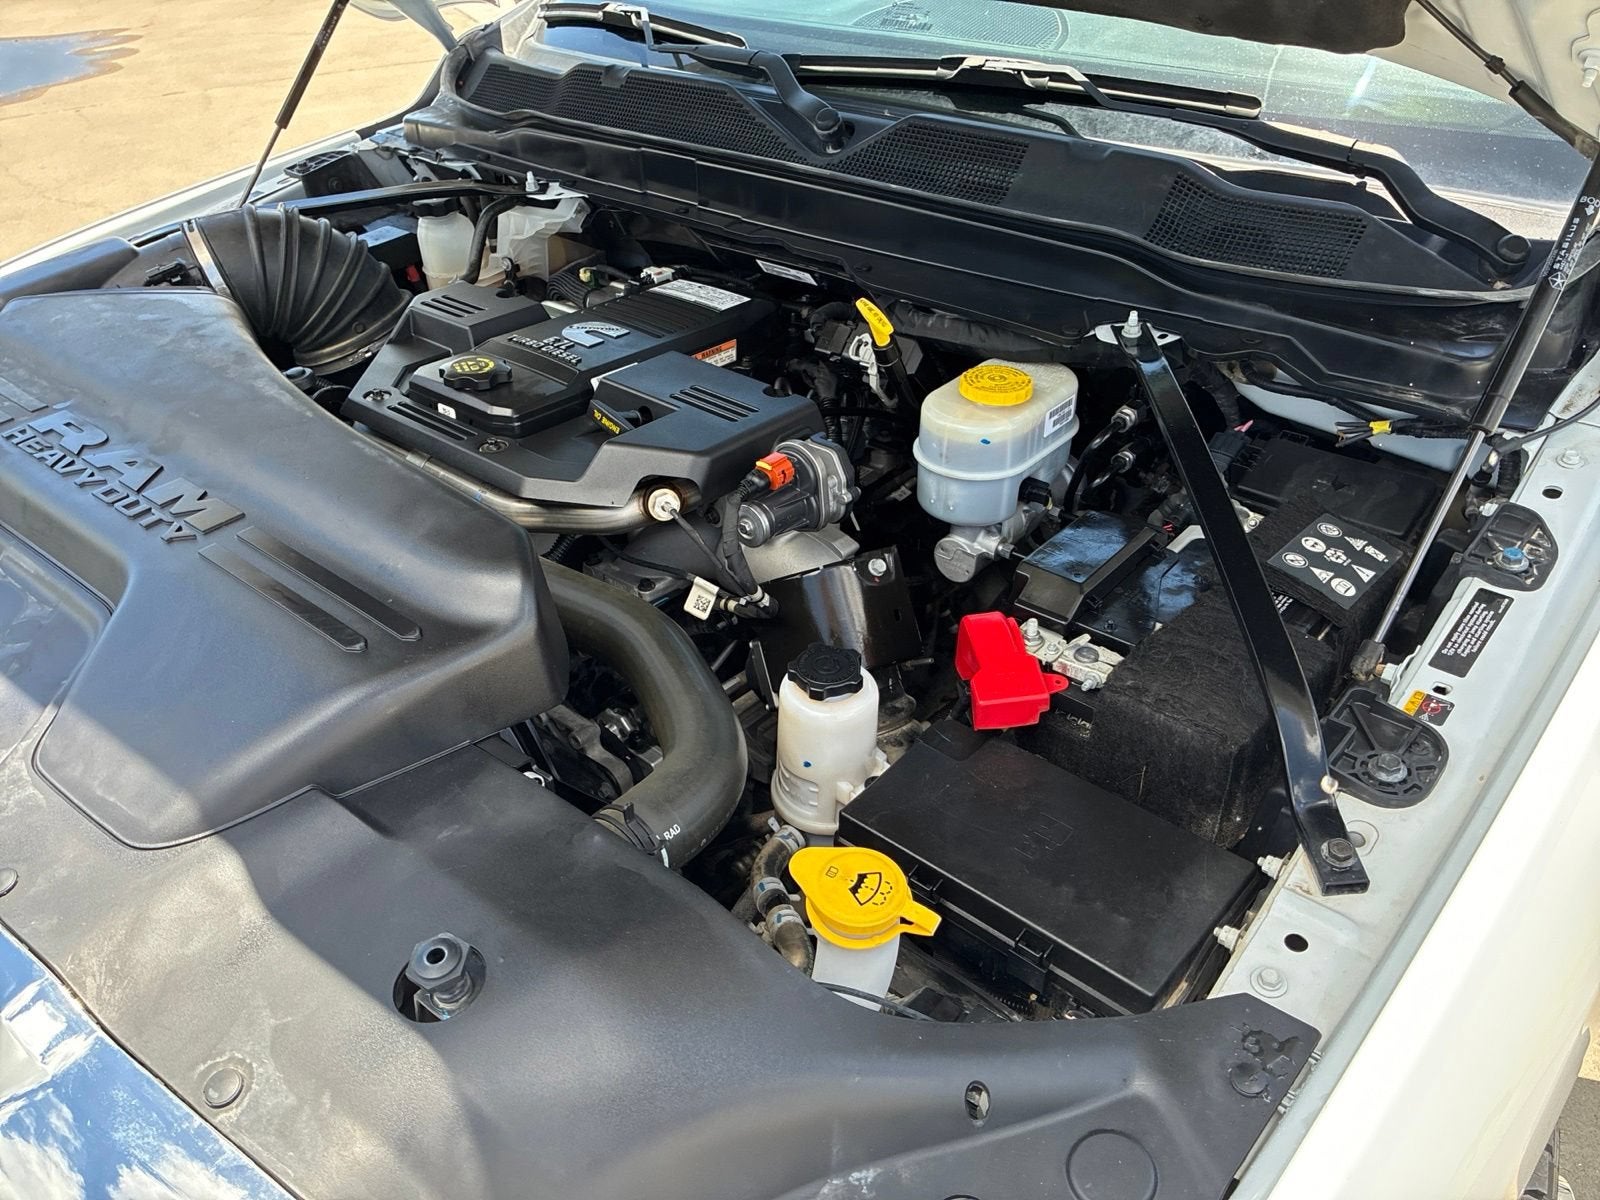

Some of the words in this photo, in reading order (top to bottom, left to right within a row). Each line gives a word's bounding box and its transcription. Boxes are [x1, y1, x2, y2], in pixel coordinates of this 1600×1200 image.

[1552, 216, 1580, 270] STABILUS
[507, 334, 545, 351] TURBO
[541, 345, 582, 366] DIESEL
[601, 416, 620, 434] ENGINE
[1, 427, 107, 488] HEAVY
[91, 483, 197, 543] DUTY
[27, 410, 246, 535] RAM
[663, 824, 681, 841] RAD
